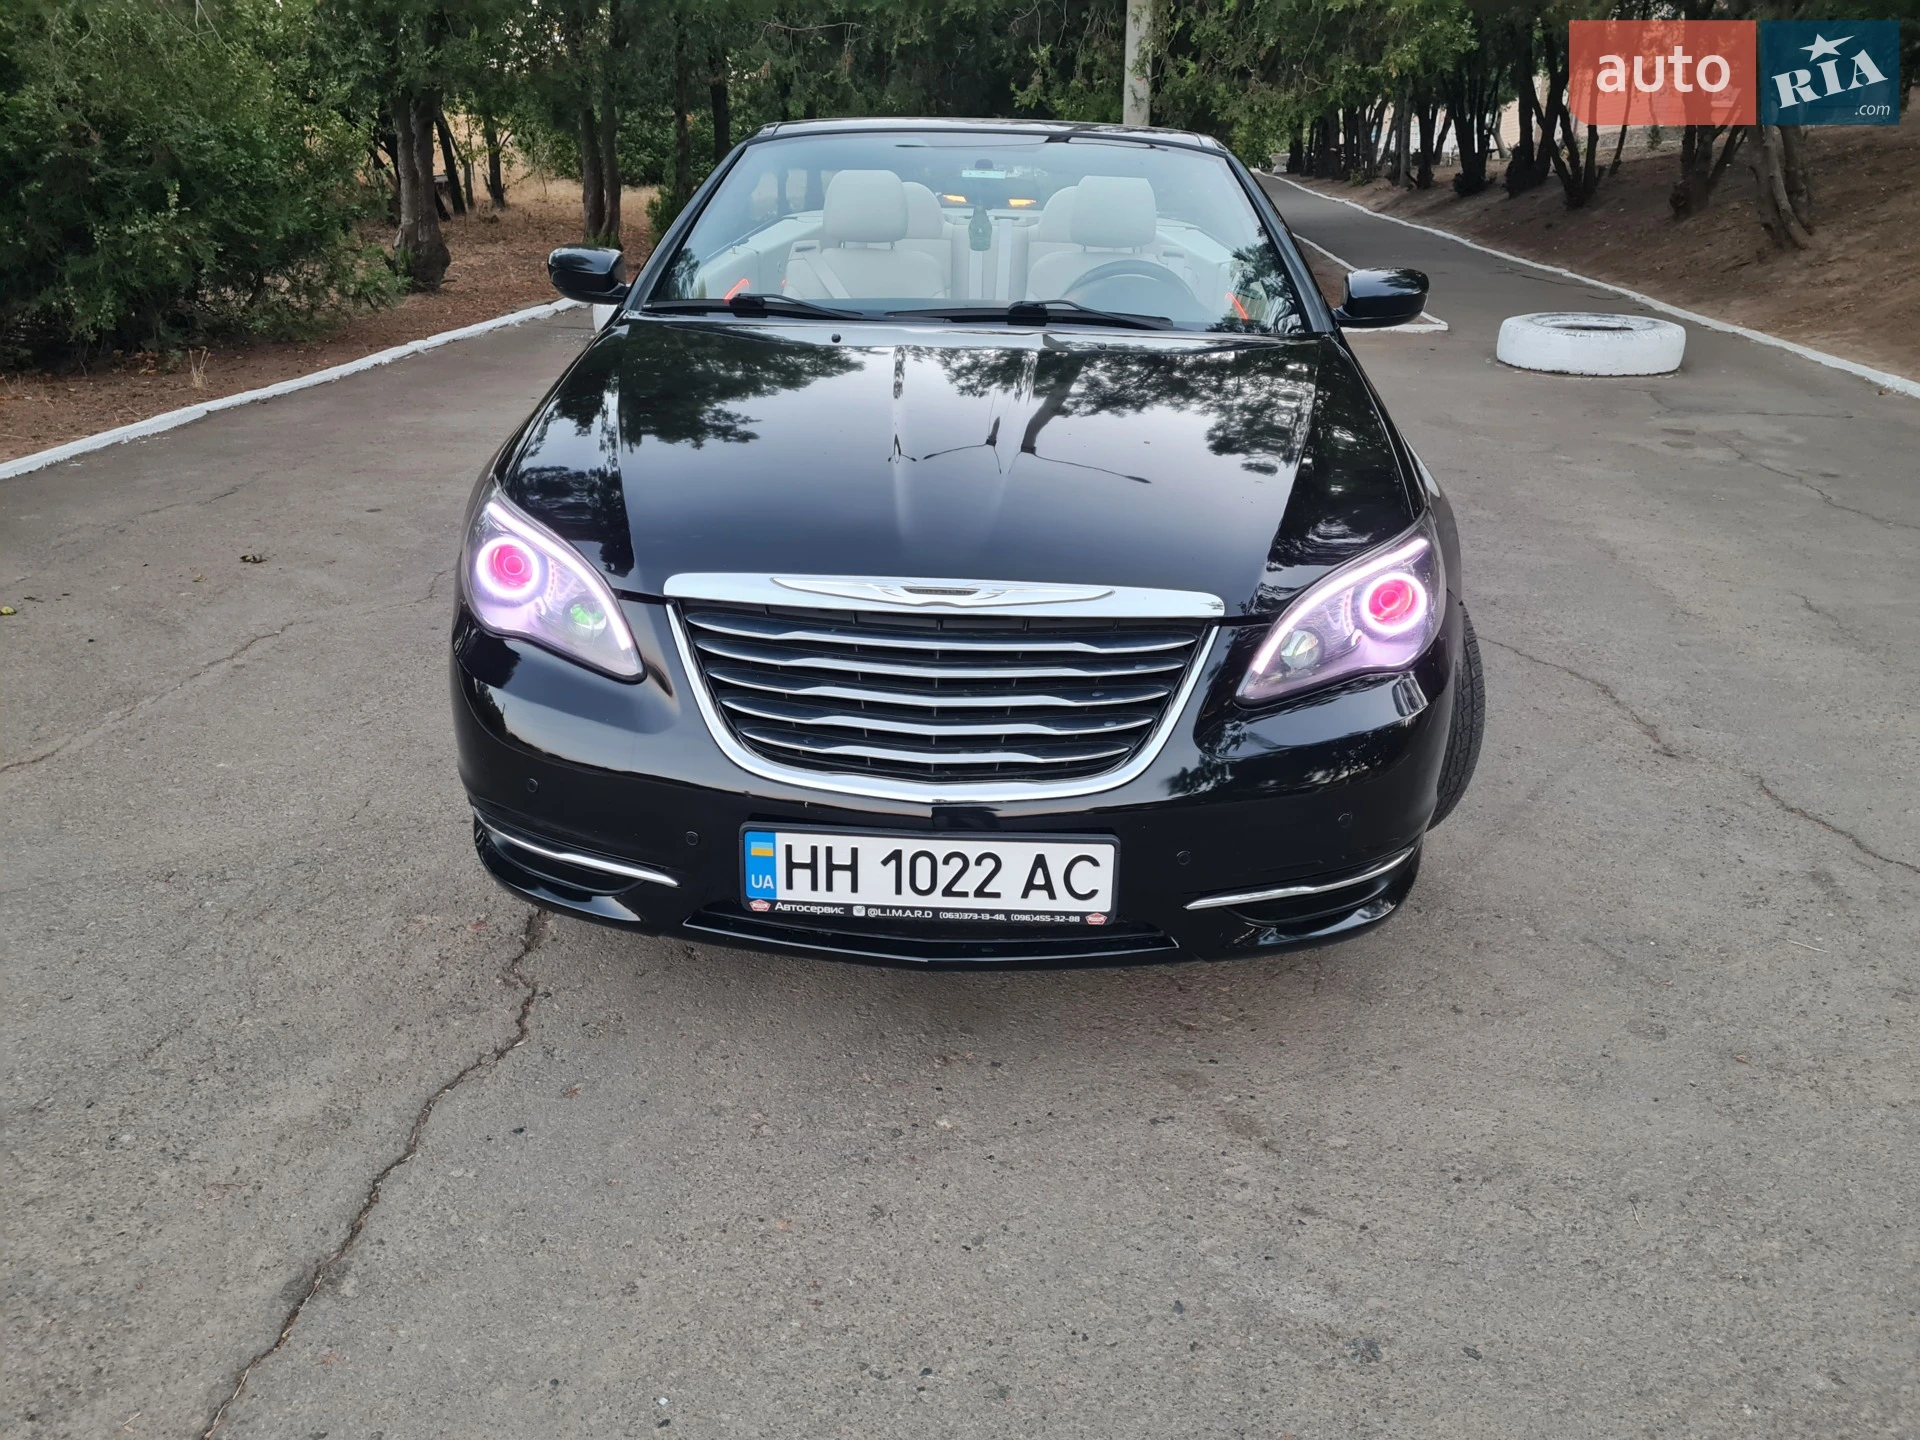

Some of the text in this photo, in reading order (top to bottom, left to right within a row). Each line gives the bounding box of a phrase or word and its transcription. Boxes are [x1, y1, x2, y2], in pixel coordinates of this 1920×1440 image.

[785, 844, 1101, 901] HH 1022 AC
[751, 874, 774, 889] UA
[774, 901, 845, 915] Автосервис
